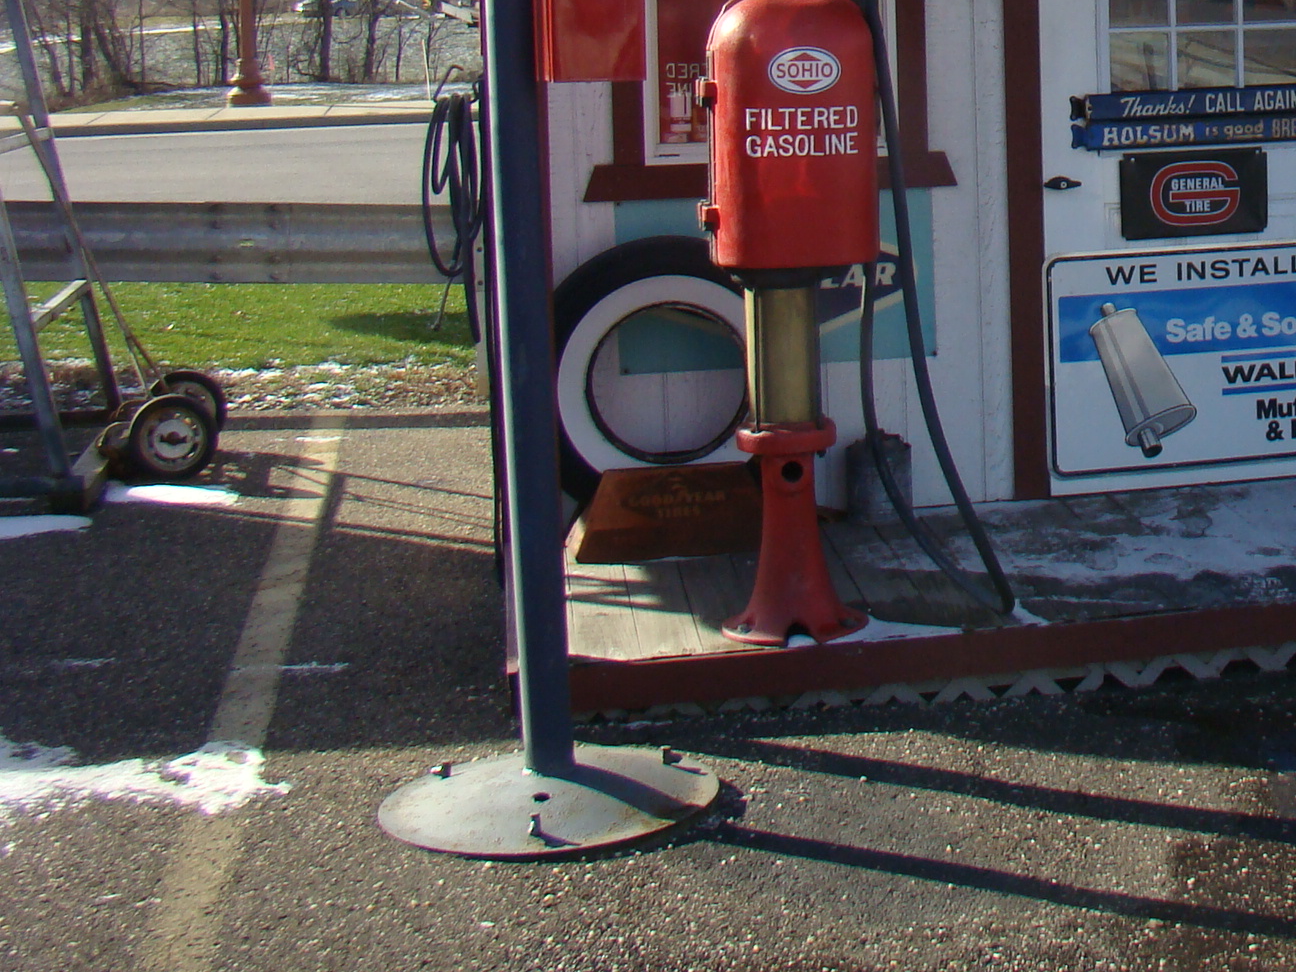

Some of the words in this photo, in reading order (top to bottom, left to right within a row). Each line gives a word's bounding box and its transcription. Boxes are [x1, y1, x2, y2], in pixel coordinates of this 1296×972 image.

[776, 62, 833, 79] SOHIO
[1120, 94, 1195, 118] Thanks!
[1205, 93, 1244, 114] CALL
[745, 106, 858, 130] FILTERED
[746, 132, 858, 158] GASOLINE
[1102, 123, 1195, 147] HOLSUM
[1205, 124, 1219, 137] is
[1223, 120, 1264, 139] good
[1171, 176, 1224, 191] GENERAL
[1184, 200, 1211, 213] TIRE
[1106, 264, 1157, 285] WE
[1166, 316, 1231, 344] Safe
[1237, 313, 1258, 338] &
[1265, 420, 1285, 442] &
